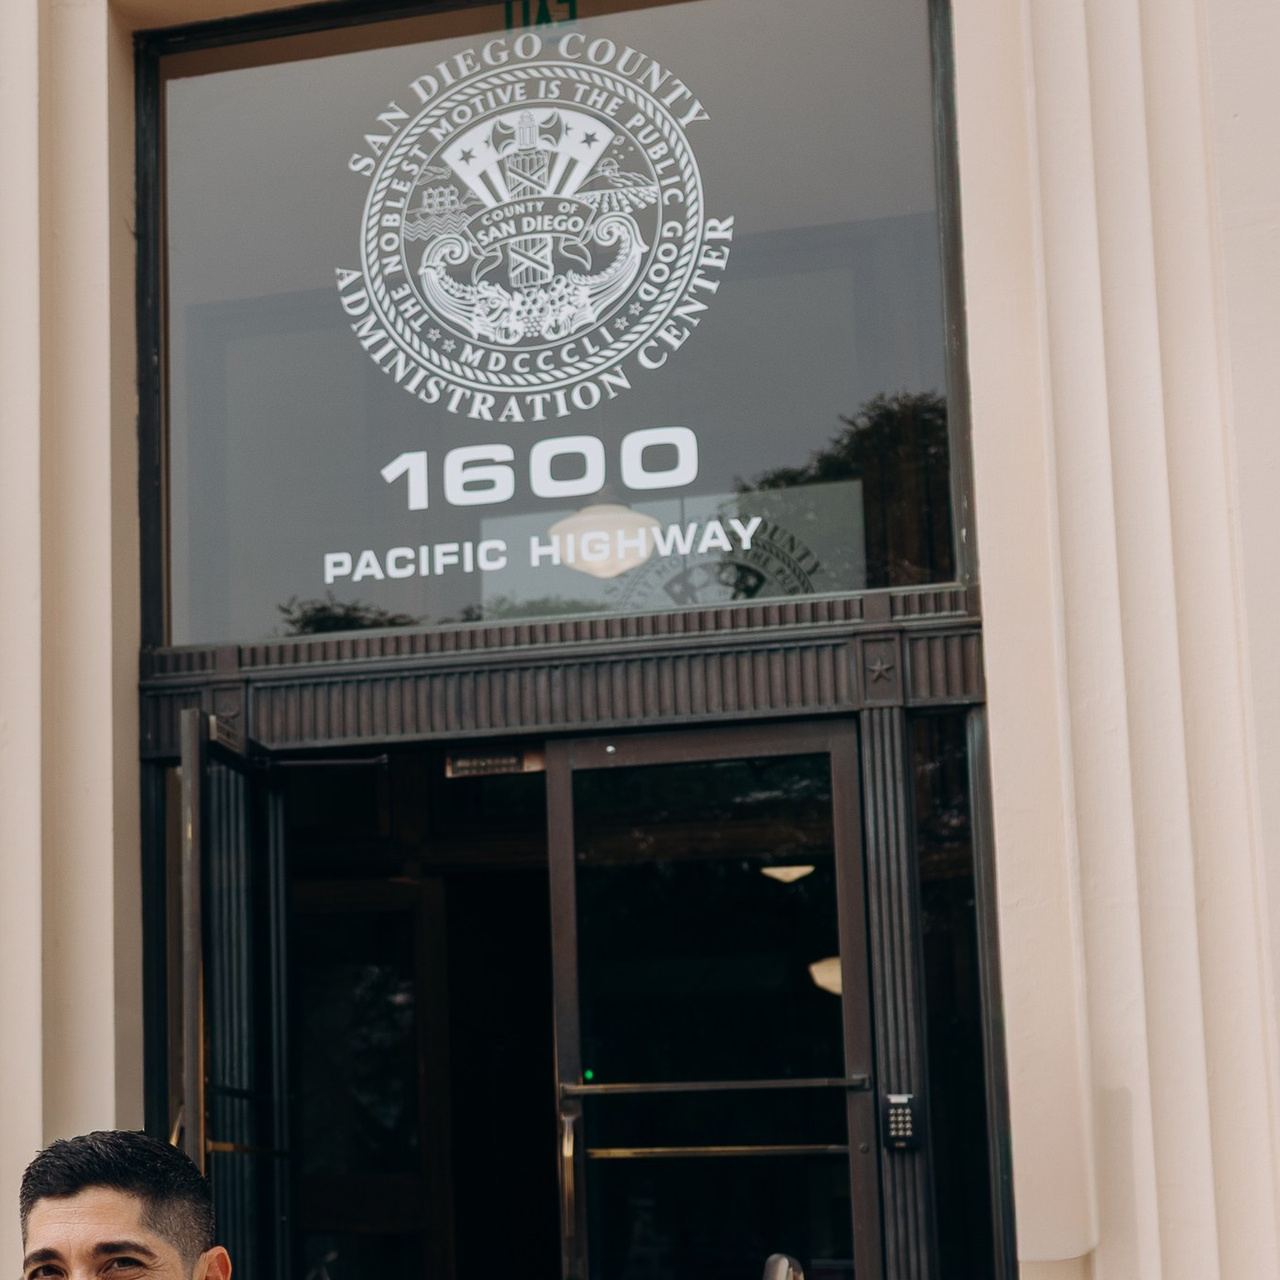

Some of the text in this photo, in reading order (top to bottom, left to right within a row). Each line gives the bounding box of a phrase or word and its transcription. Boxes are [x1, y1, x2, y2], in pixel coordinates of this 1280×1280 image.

[348, 32, 712, 177] SAN DIEGO COUNTY
[379, 80, 685, 333] THE NOBLEST MOTIVE IS THE PUBLIC GOOD
[476, 214, 585, 246] SAN DIEGO
[481, 200, 579, 226] COUNTY OF
[335, 215, 735, 422] ADMINISTRATION CENTER
[380, 426, 700, 511] 1600
[324, 516, 763, 585] PACIFIC HIGHWAY
